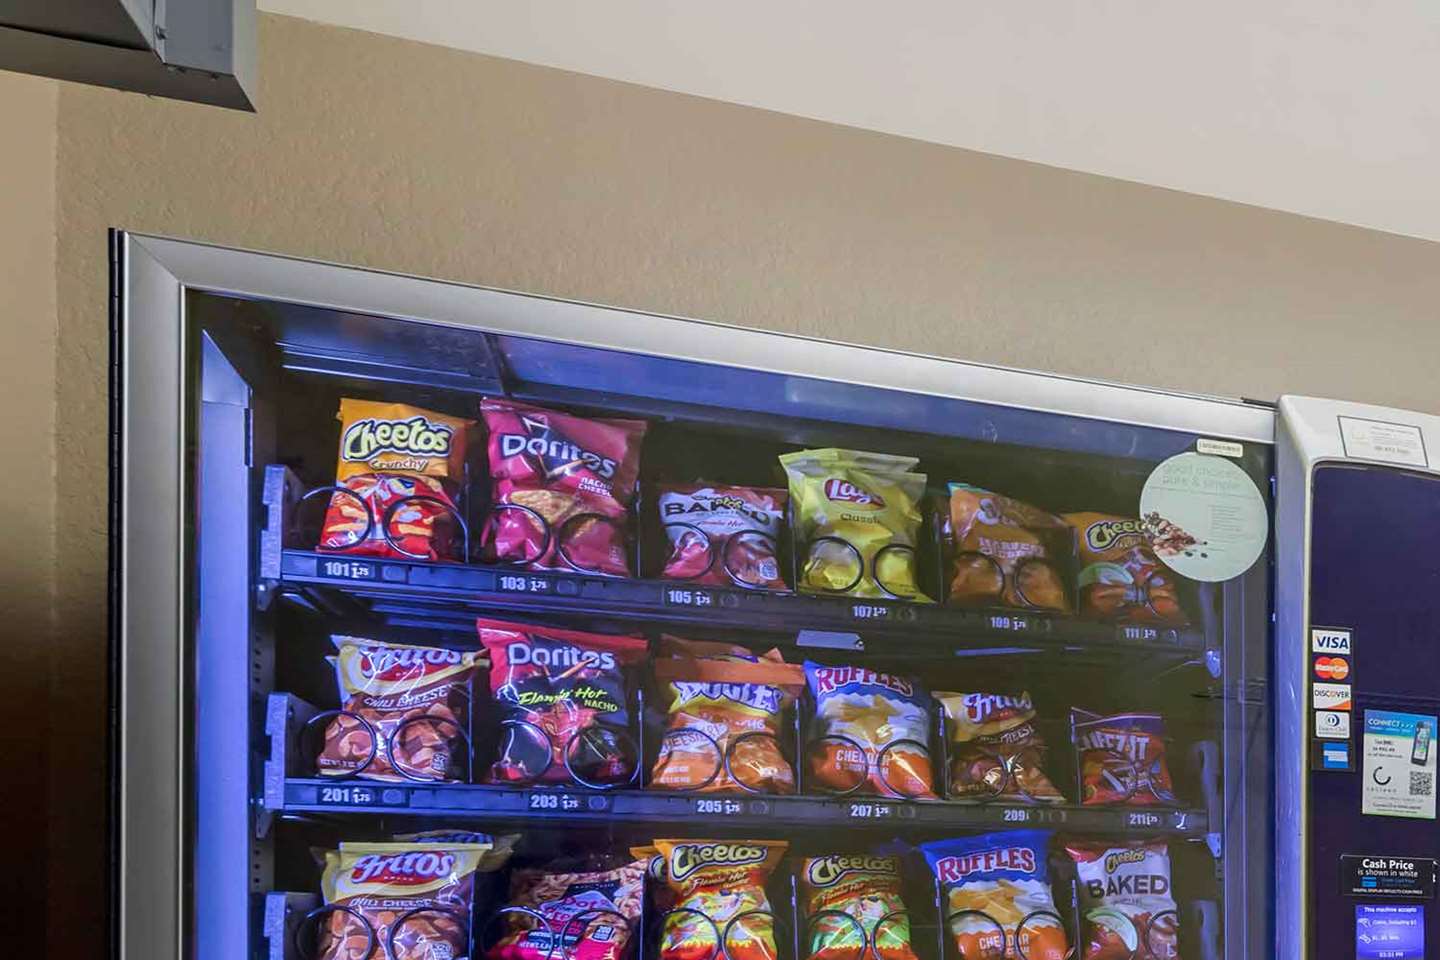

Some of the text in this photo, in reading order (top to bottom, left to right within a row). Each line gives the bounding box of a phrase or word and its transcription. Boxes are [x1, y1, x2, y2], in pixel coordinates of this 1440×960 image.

[344, 417, 453, 461] Cheetos
[502, 434, 618, 477] Doritos
[369, 458, 428, 472] Crunchy
[325, 562, 349, 576] 101
[500, 576, 525, 590] 103
[668, 590, 691, 604] 105
[853, 606, 873, 618] 107
[1317, 636, 1348, 649] VISA
[508, 643, 616, 670] Doritos
[815, 666, 913, 697] RUFFLES
[572, 686, 607, 699] Hot
[1314, 689, 1349, 698] DISCOVER
[584, 698, 618, 712] NACHO
[322, 789, 348, 803] 201
[531, 795, 557, 808] 203
[697, 800, 722, 813] 205
[851, 805, 871, 817] 207
[1130, 814, 1146, 825] 211
[351, 852, 455, 883] Fritos
[671, 844, 768, 880] Cheetos
[937, 849, 1036, 882] RUFFLES
[1104, 850, 1145, 873] Cheetos
[1362, 859, 1414, 870] Cash Price
[809, 855, 898, 886] Cheetos
[1365, 868, 1388, 876] shown
[1086, 875, 1168, 898] BAKED
